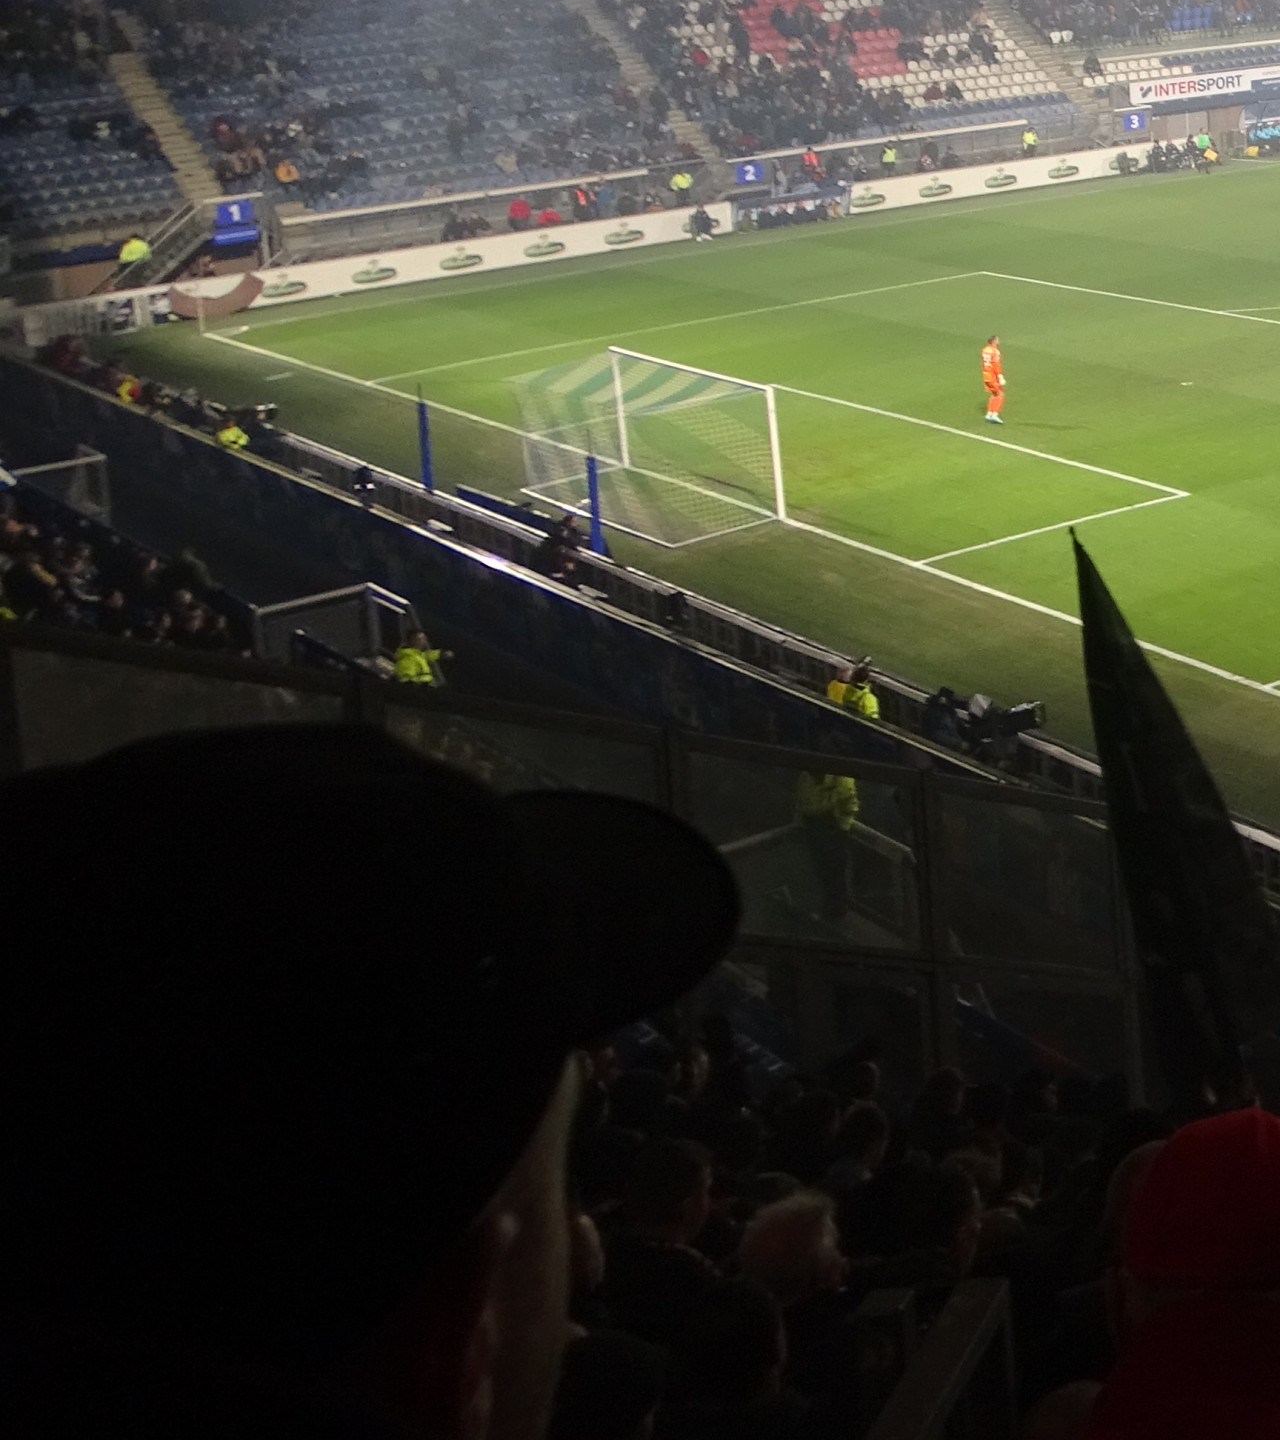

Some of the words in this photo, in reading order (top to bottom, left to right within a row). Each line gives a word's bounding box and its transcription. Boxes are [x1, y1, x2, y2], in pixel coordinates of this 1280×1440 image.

[1154, 74, 1242, 97] INTERSPORT
[1130, 115, 1139, 129] 3
[744, 165, 756, 181] 2
[228, 204, 241, 221] 1
